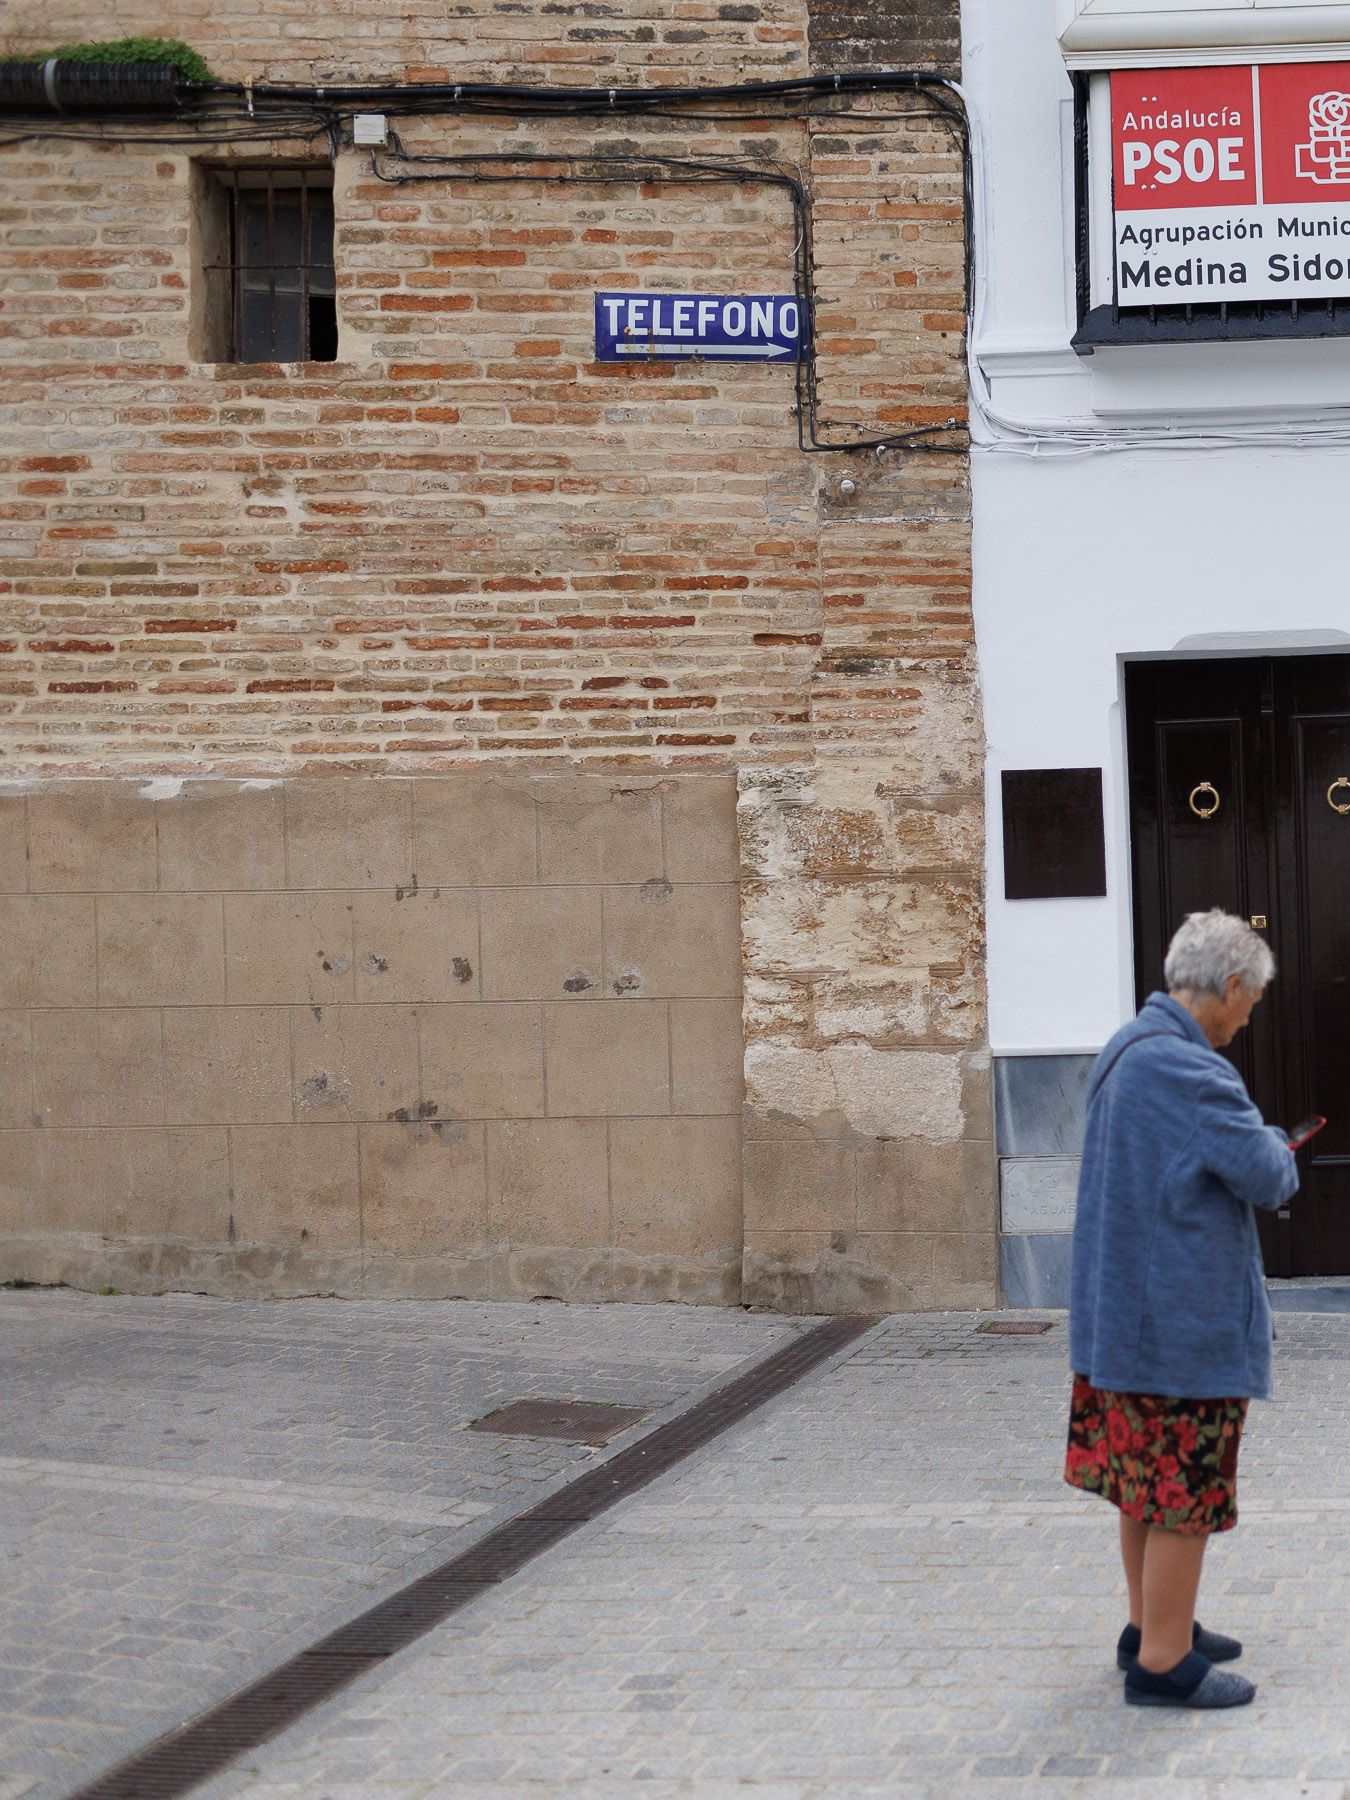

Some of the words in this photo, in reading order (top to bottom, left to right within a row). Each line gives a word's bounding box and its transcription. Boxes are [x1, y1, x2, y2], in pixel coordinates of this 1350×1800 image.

[1122, 106, 1241, 130] Andalucía
[1122, 137, 1245, 185] PSOE
[1119, 218, 1263, 250] Agrupación
[1121, 258, 1247, 288] Medina
[603, 299, 799, 338] TELEFONO
